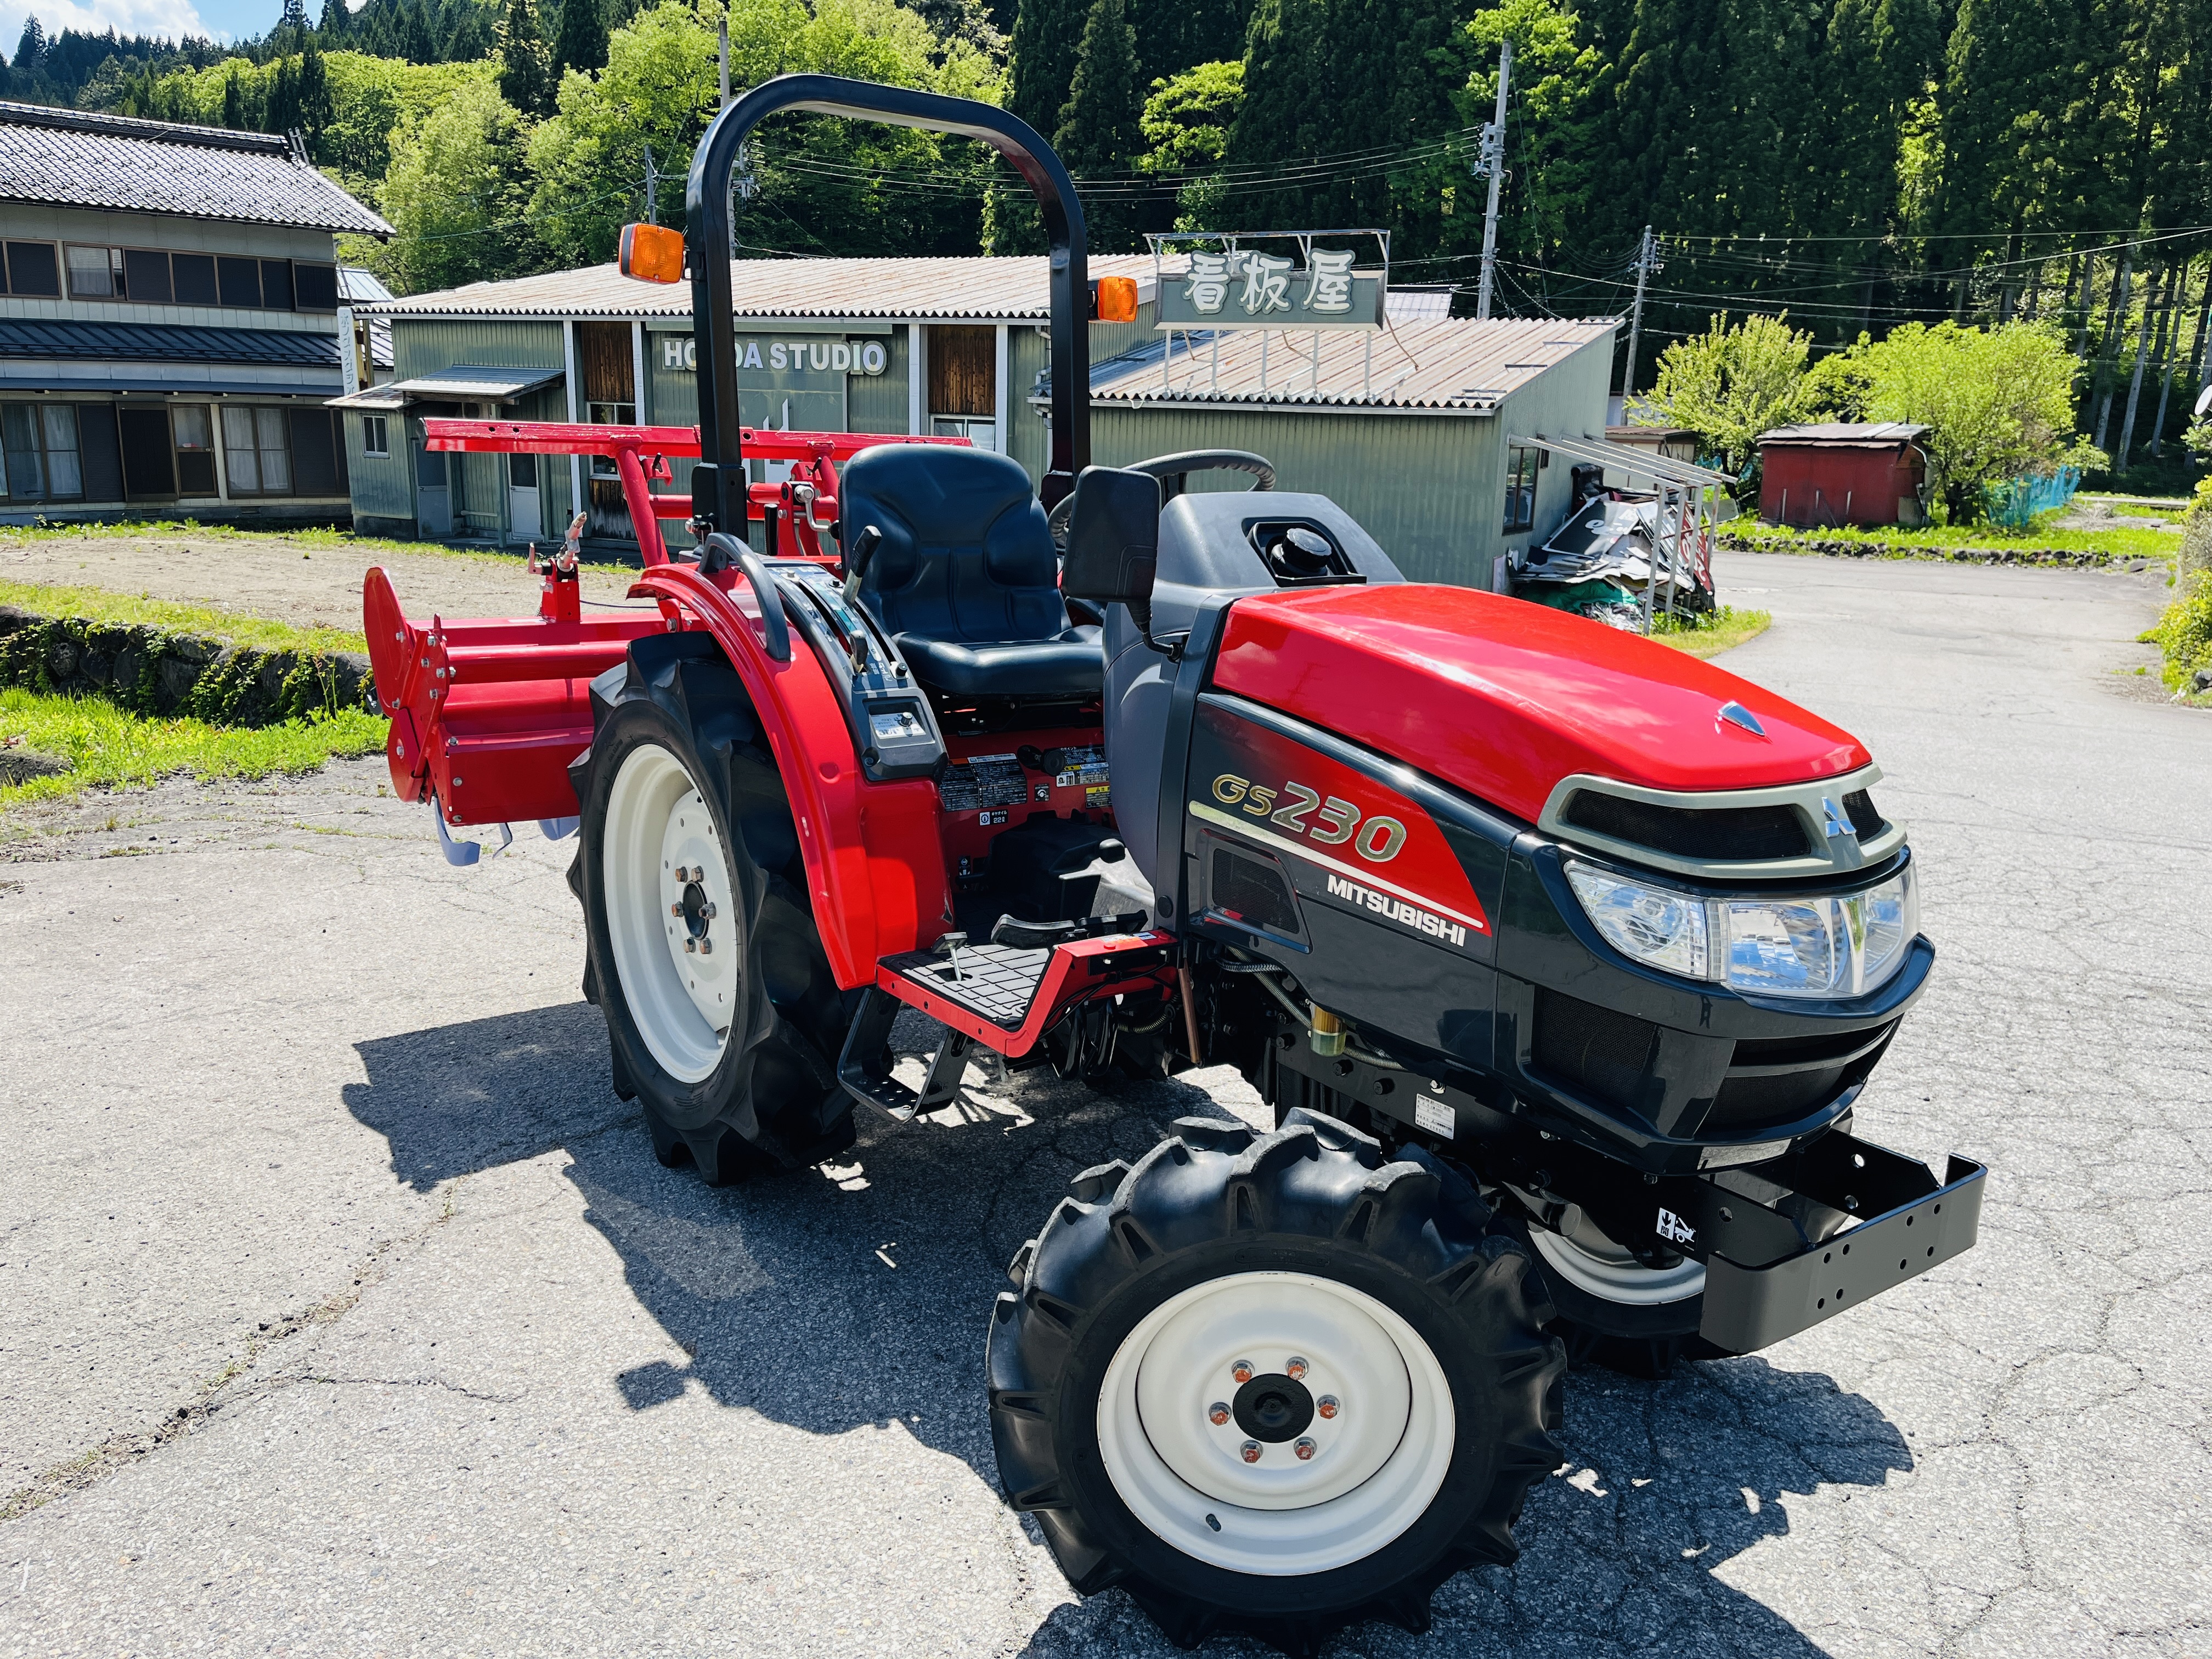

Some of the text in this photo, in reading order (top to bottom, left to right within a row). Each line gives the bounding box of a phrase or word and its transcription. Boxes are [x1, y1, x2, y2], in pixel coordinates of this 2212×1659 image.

[1184, 251, 1353, 312] 看板屋
[769, 342, 884, 371] STUDIO
[1211, 774, 1407, 863] GS230
[1327, 873, 1466, 947] MITSUBISHI
